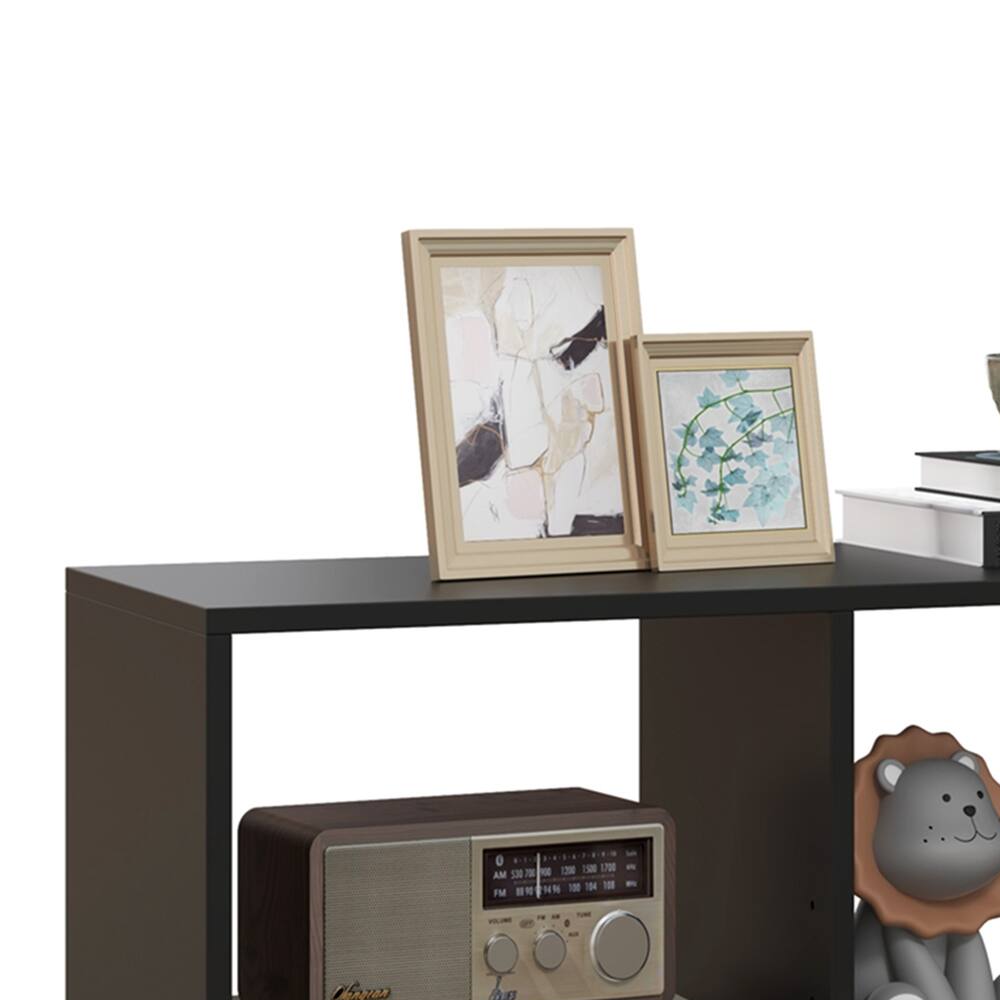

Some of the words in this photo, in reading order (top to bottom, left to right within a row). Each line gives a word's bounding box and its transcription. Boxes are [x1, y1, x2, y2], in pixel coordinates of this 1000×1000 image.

[493, 871, 507, 880] AM
[600, 862, 616, 872] 1700
[493, 888, 506, 897] FM
